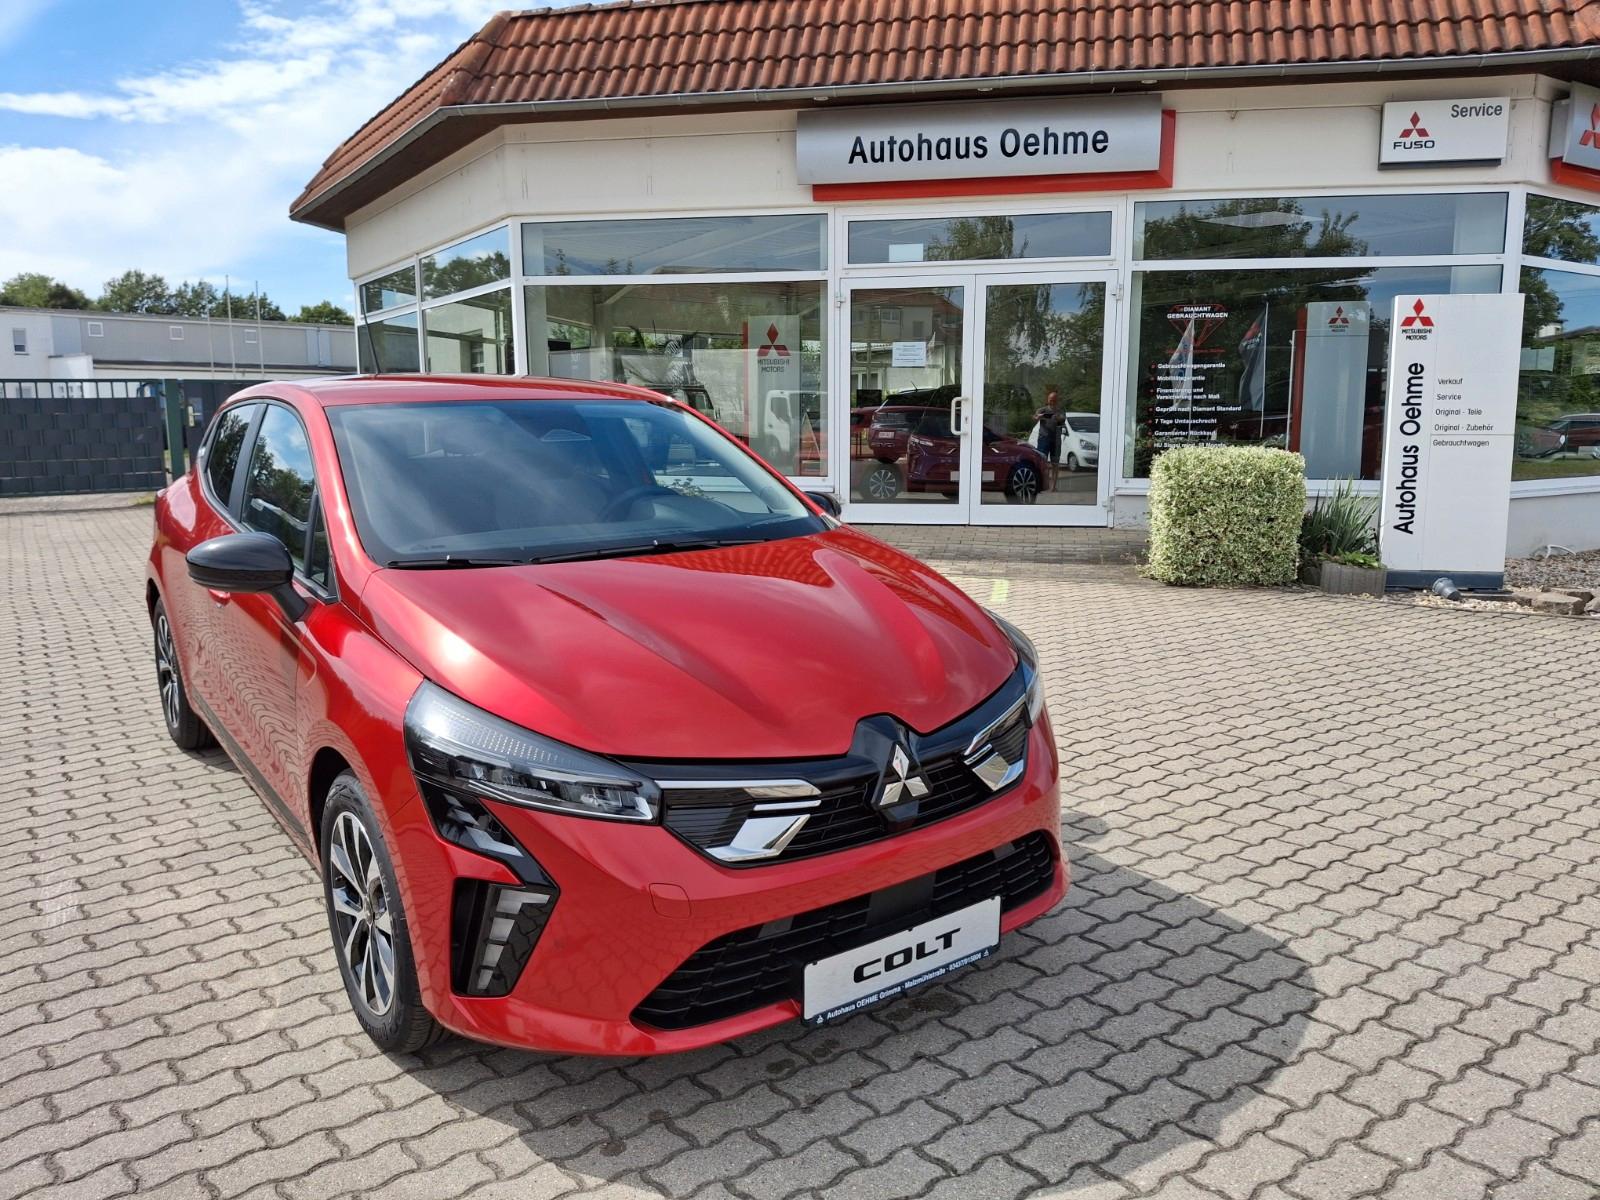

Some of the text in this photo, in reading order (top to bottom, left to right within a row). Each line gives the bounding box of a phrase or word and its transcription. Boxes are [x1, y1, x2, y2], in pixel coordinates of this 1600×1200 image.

[1450, 103, 1503, 118] Service
[848, 128, 1109, 164] Autohaus Oehme
[1393, 140, 1435, 150] FUSO
[1435, 408, 1461, 417] Original
[1434, 423, 1460, 432] Original
[1466, 423, 1494, 431] Zubehör
[1393, 362, 1425, 535] Autohaus Oehme
[1432, 438, 1490, 447] Gebrauchtwagen
[853, 927, 961, 984] COLT
[826, 1004, 856, 1020] Autohaus
[856, 993, 879, 1009] OEHME
